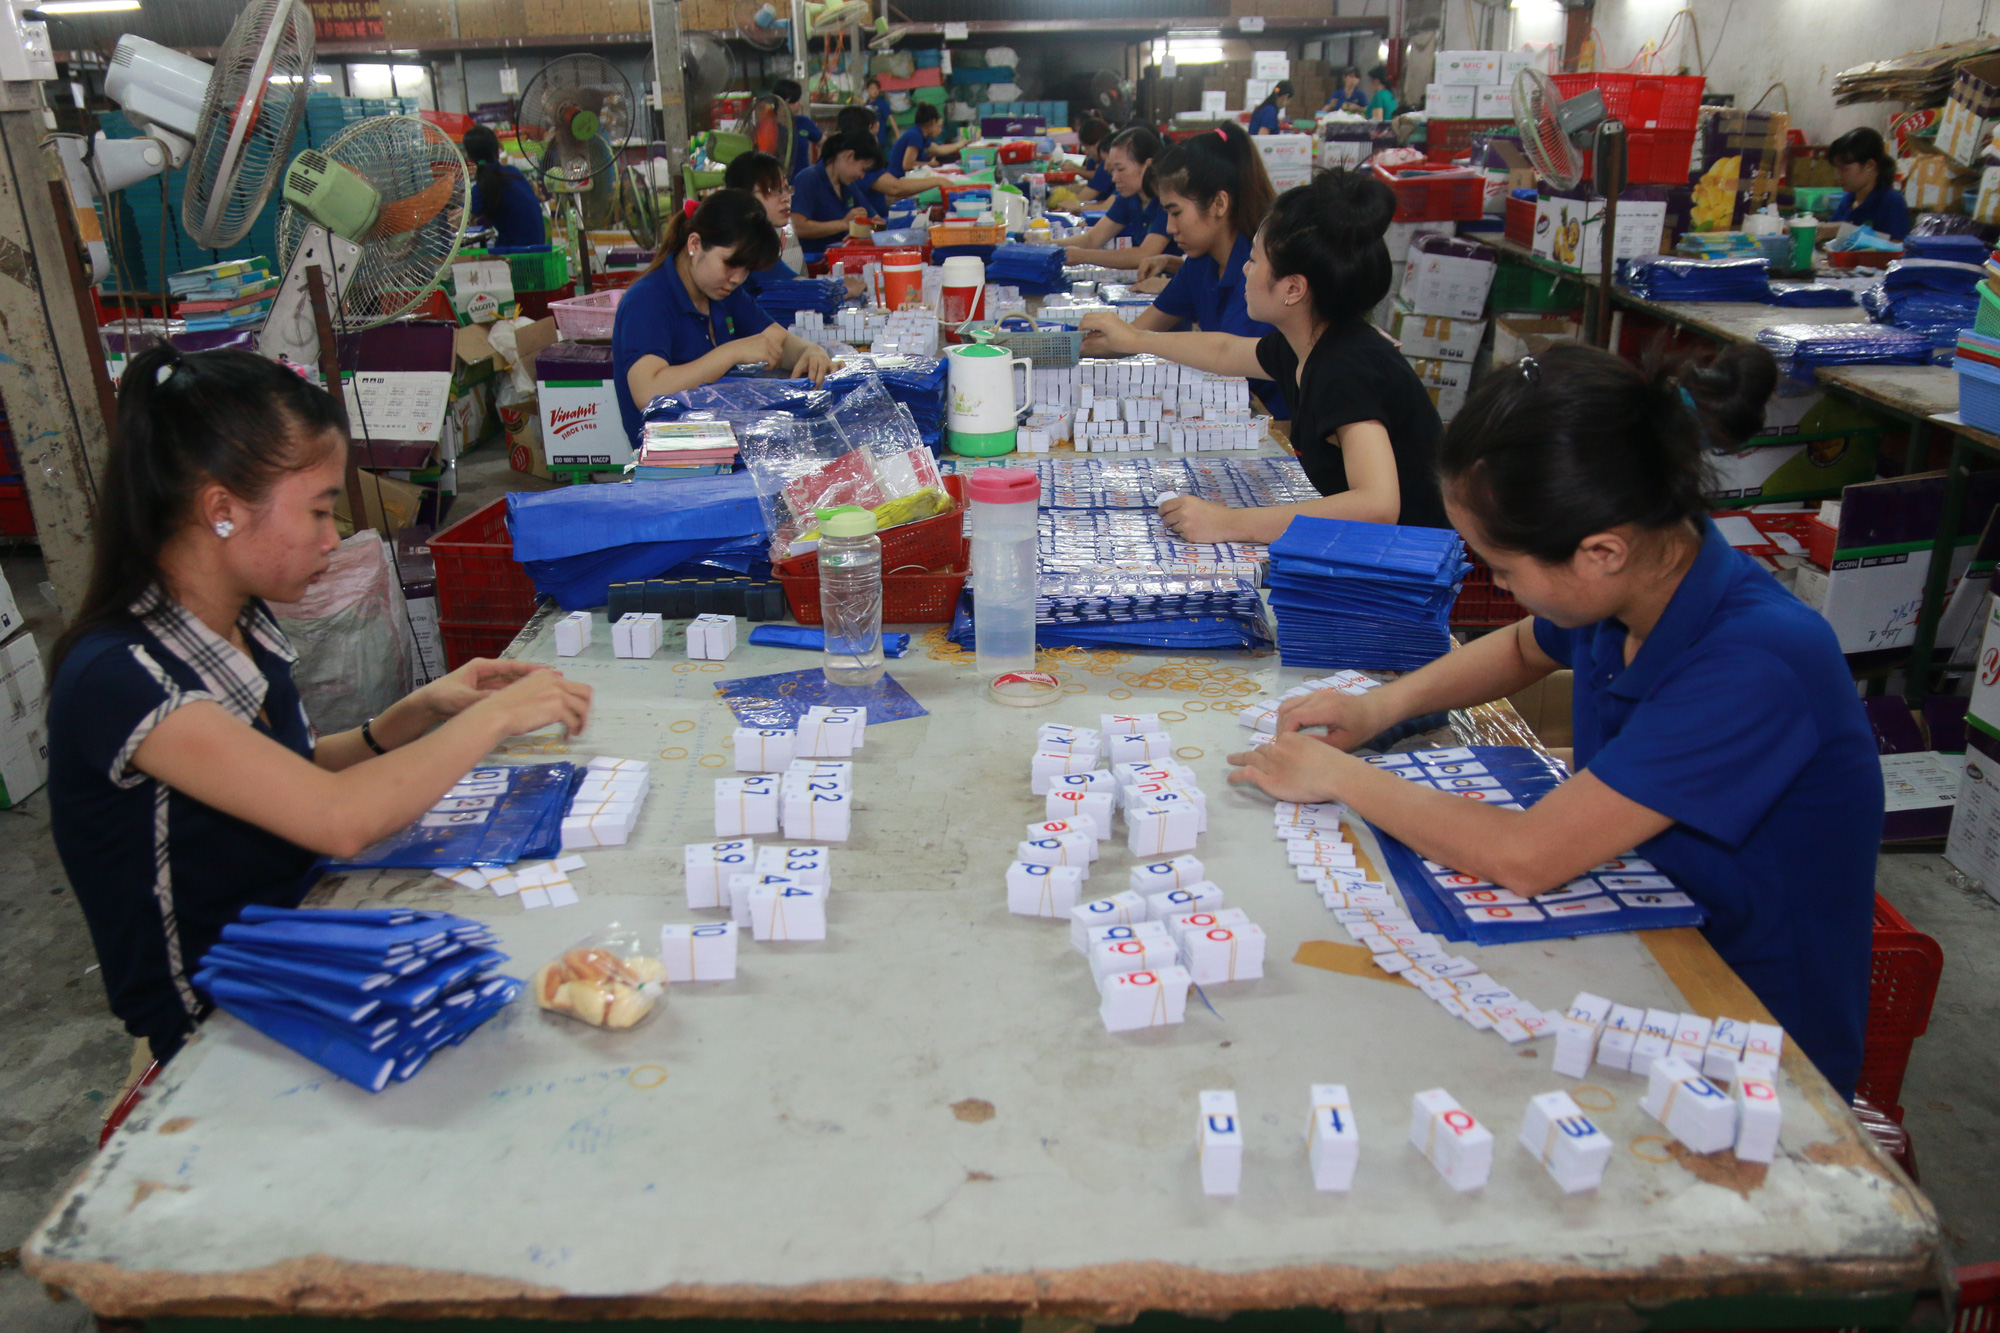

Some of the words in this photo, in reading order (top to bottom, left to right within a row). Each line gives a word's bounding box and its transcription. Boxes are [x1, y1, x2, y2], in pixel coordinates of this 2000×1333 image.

[1904, 112, 1926, 131] 333
[470, 301, 496, 313] SAGOTA
[549, 402, 601, 427] Vinamit
[561, 427, 580, 440] SINCE
[1835, 560, 1859, 570] HACCP
[758, 729, 786, 737] 5
[1047, 736, 1074, 744] k
[744, 776, 773, 785] 6
[1063, 773, 1095, 785] g
[809, 782, 838, 791] 2
[814, 793, 843, 802] 2
[1055, 791, 1085, 801] ê
[1156, 793, 1178, 802] s
[456, 798, 486, 807] 2
[450, 813, 478, 822] 3
[1044, 821, 1067, 832] e
[712, 842, 745, 851] 8
[1029, 837, 1062, 849] đ
[788, 848, 819, 857] 3
[713, 854, 745, 863] 9
[786, 861, 818, 870] 3
[1021, 862, 1051, 876] d
[760, 875, 792, 884] 4
[780, 887, 813, 897] 4
[1168, 889, 1204, 904] p
[1089, 900, 1115, 913] c
[1181, 913, 1215, 926] ô
[692, 922, 728, 937] 10
[1102, 926, 1133, 940] b
[1206, 928, 1233, 941] o
[1109, 941, 1145, 954] â
[1118, 971, 1157, 986] ă
